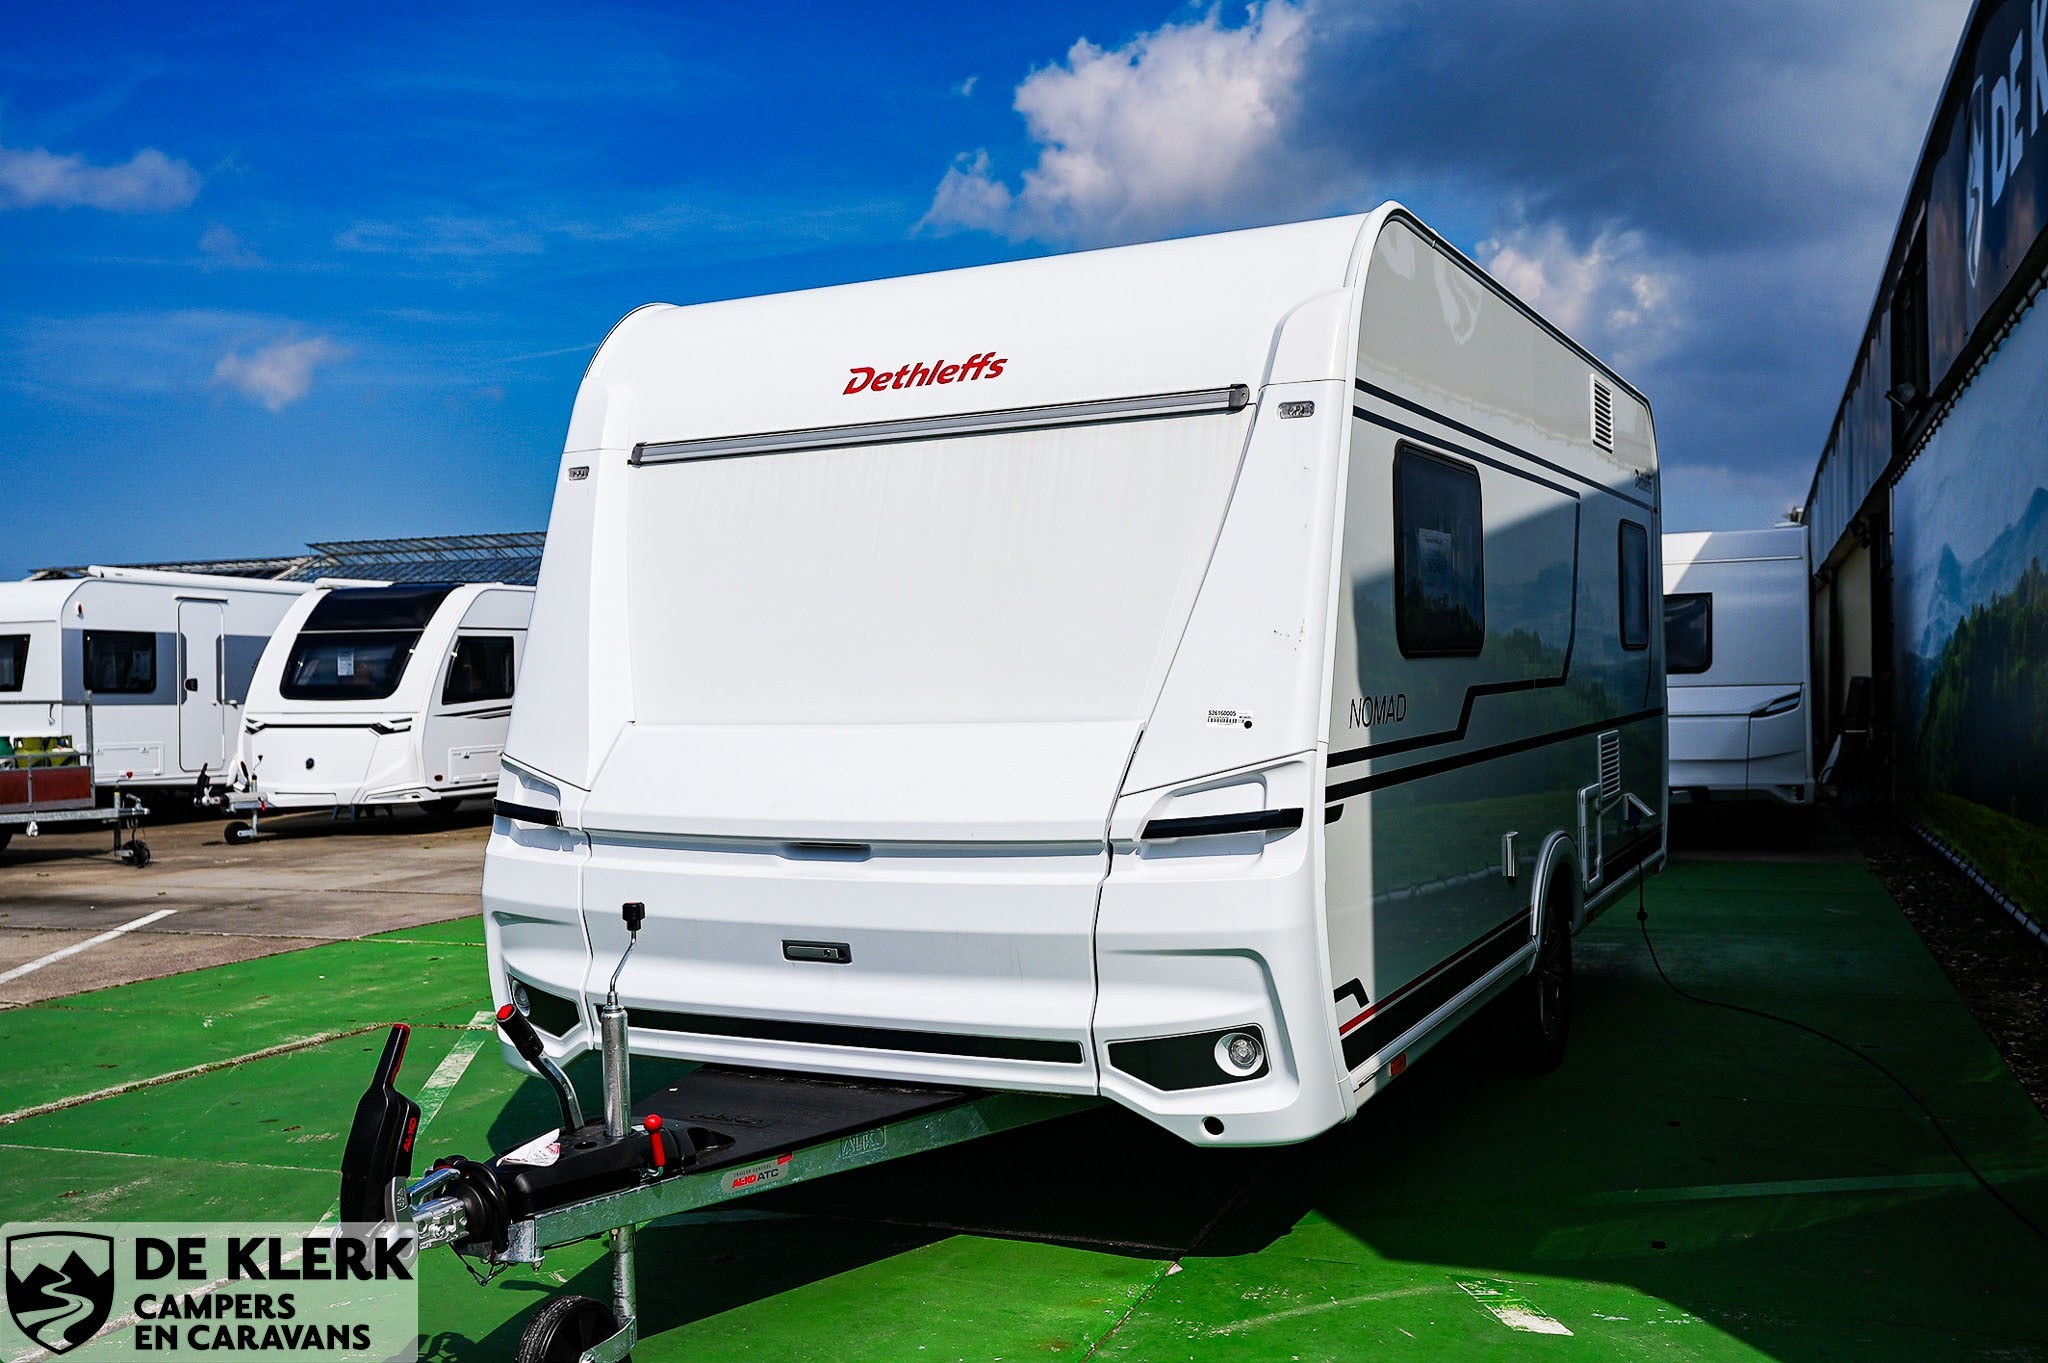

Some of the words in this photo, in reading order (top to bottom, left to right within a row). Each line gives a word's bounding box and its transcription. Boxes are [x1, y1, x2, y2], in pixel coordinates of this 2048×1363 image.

[1991, 28, 2023, 208] DE
[842, 351, 1009, 395] Dethleffs
[1349, 693, 1407, 730] NOMAD
[757, 1168, 779, 1182] ATC
